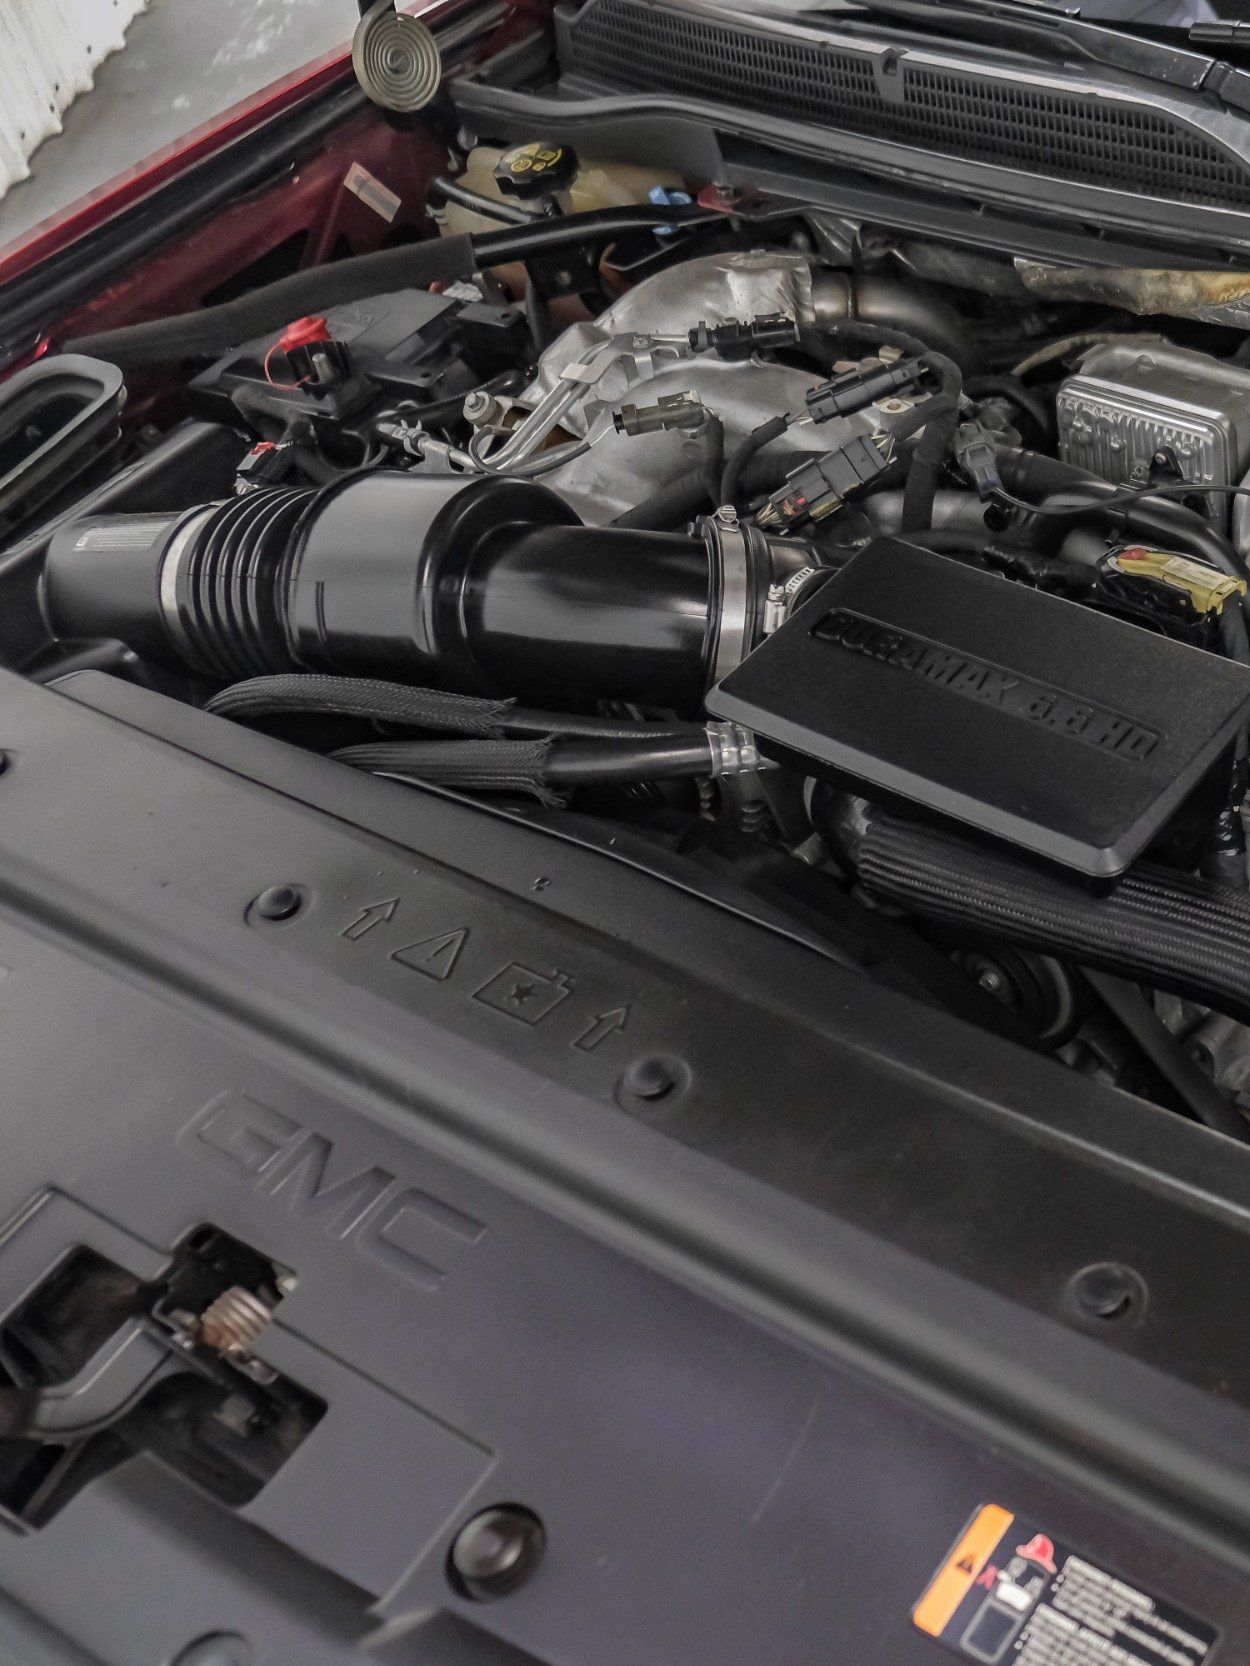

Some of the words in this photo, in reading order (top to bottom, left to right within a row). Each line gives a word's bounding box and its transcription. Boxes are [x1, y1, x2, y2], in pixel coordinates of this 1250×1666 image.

[815, 609, 1019, 706] DURAMAX
[1024, 692, 1096, 736] 6.6
[1098, 718, 1161, 762] HD
[175, 1089, 489, 1292] GMC
